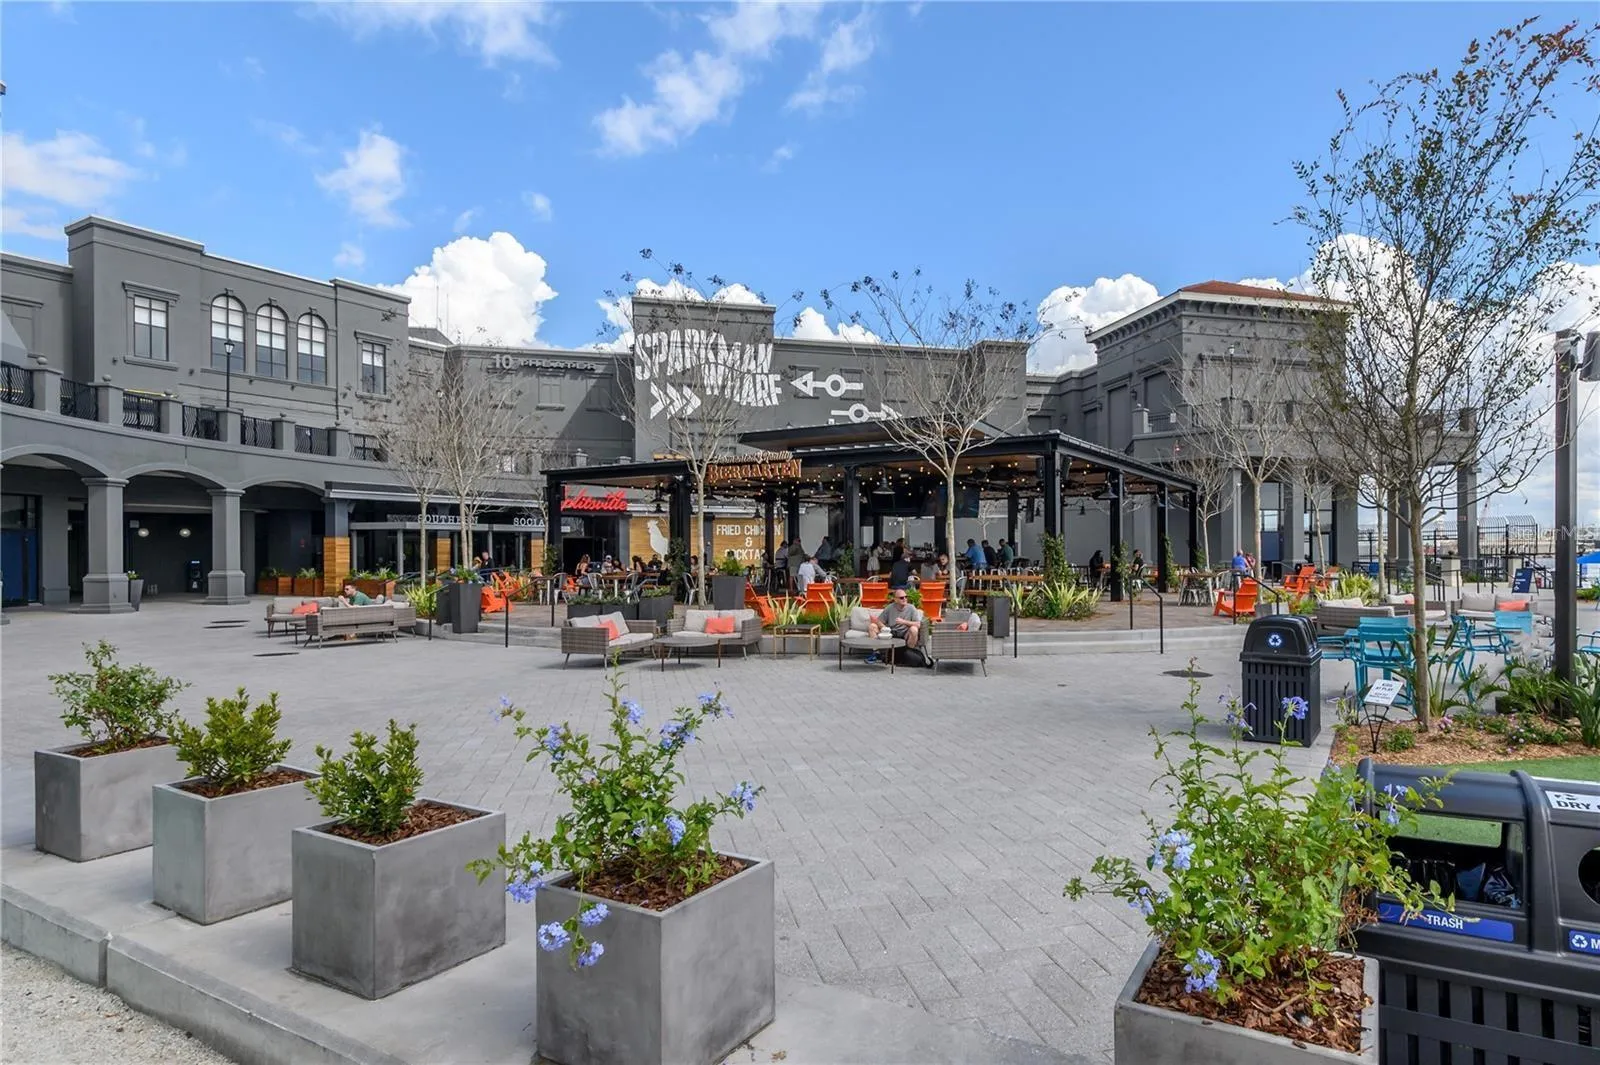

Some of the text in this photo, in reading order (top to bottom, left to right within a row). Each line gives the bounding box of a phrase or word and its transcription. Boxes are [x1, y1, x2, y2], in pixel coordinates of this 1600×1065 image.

[635, 328, 774, 380] SPARKMAN
[700, 361, 782, 407] WHARF
[708, 458, 802, 481] BIERGARTEN
[561, 485, 627, 511] plitsville
[514, 517, 545, 527] SOCIA
[716, 524, 781, 536] FRIED CHICN
[745, 536, 753, 547] &
[724, 548, 766, 561] COCKTA
[1556, 800, 1590, 810] DRY
[1427, 914, 1464, 930] TRASH
